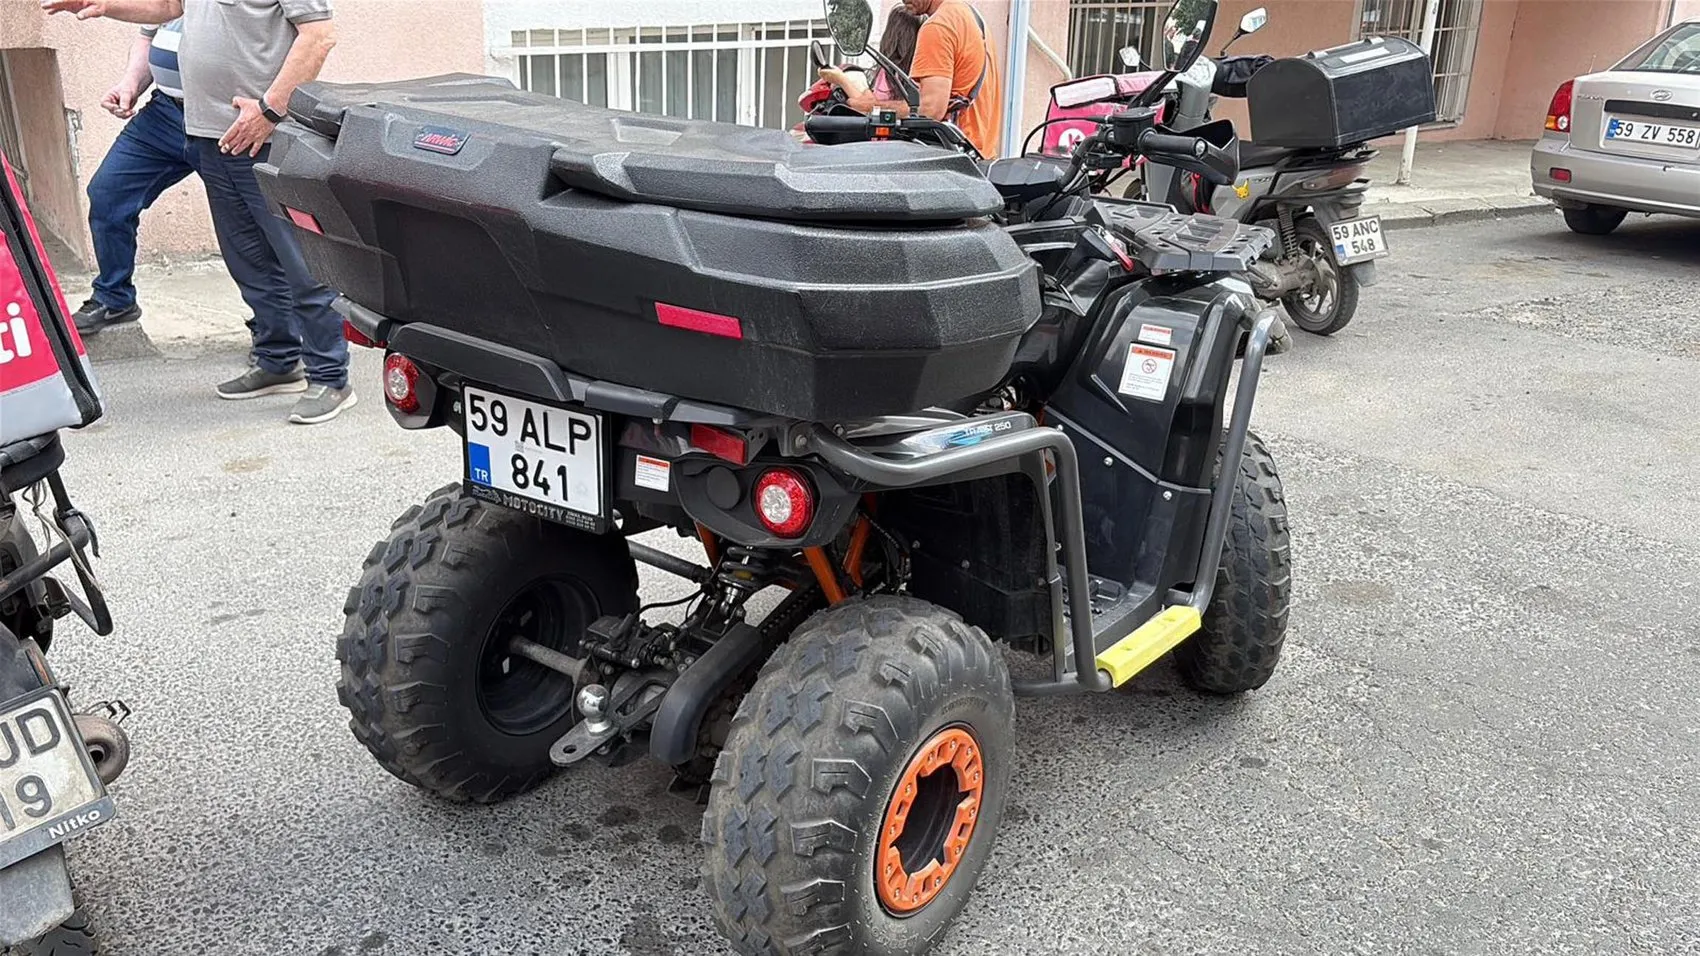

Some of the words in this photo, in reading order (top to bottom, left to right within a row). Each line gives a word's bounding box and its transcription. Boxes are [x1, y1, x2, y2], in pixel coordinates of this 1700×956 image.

[1615, 122, 1633, 137] 59
[1641, 125, 1661, 140] ZV
[1667, 128, 1695, 144] 558
[1333, 225, 1349, 240] 59
[1353, 220, 1378, 237] ANC
[1352, 238, 1375, 254] 548
[470, 393, 508, 437] 59
[520, 408, 591, 455] ALP
[994, 421, 1012, 431] 250
[475, 468, 489, 482] TR
[511, 453, 568, 501] 841
[503, 494, 565, 522] MOTOCITY
[48, 809, 101, 840] Nitko
